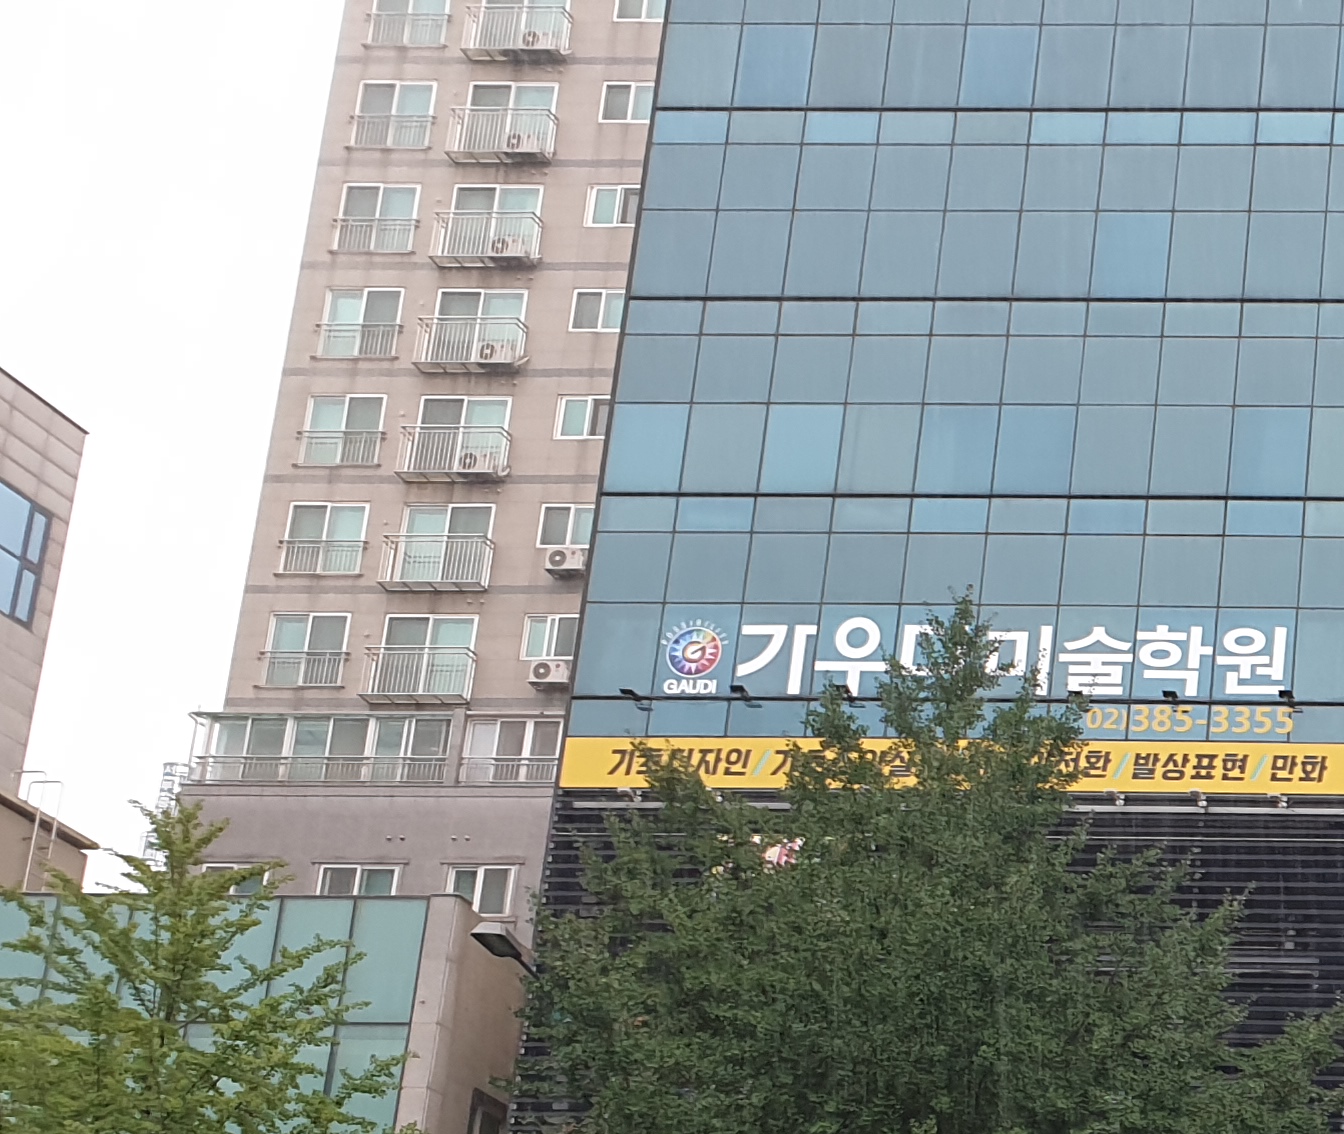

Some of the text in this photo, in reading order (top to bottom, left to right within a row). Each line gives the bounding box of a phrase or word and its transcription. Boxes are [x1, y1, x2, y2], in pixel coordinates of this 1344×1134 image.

[663, 678, 718, 695] GAUDI
[1086, 705, 1295, 735] 02)385-3355
[1131, 752, 1249, 782] 발상표현
[1269, 754, 1328, 784] 만화
